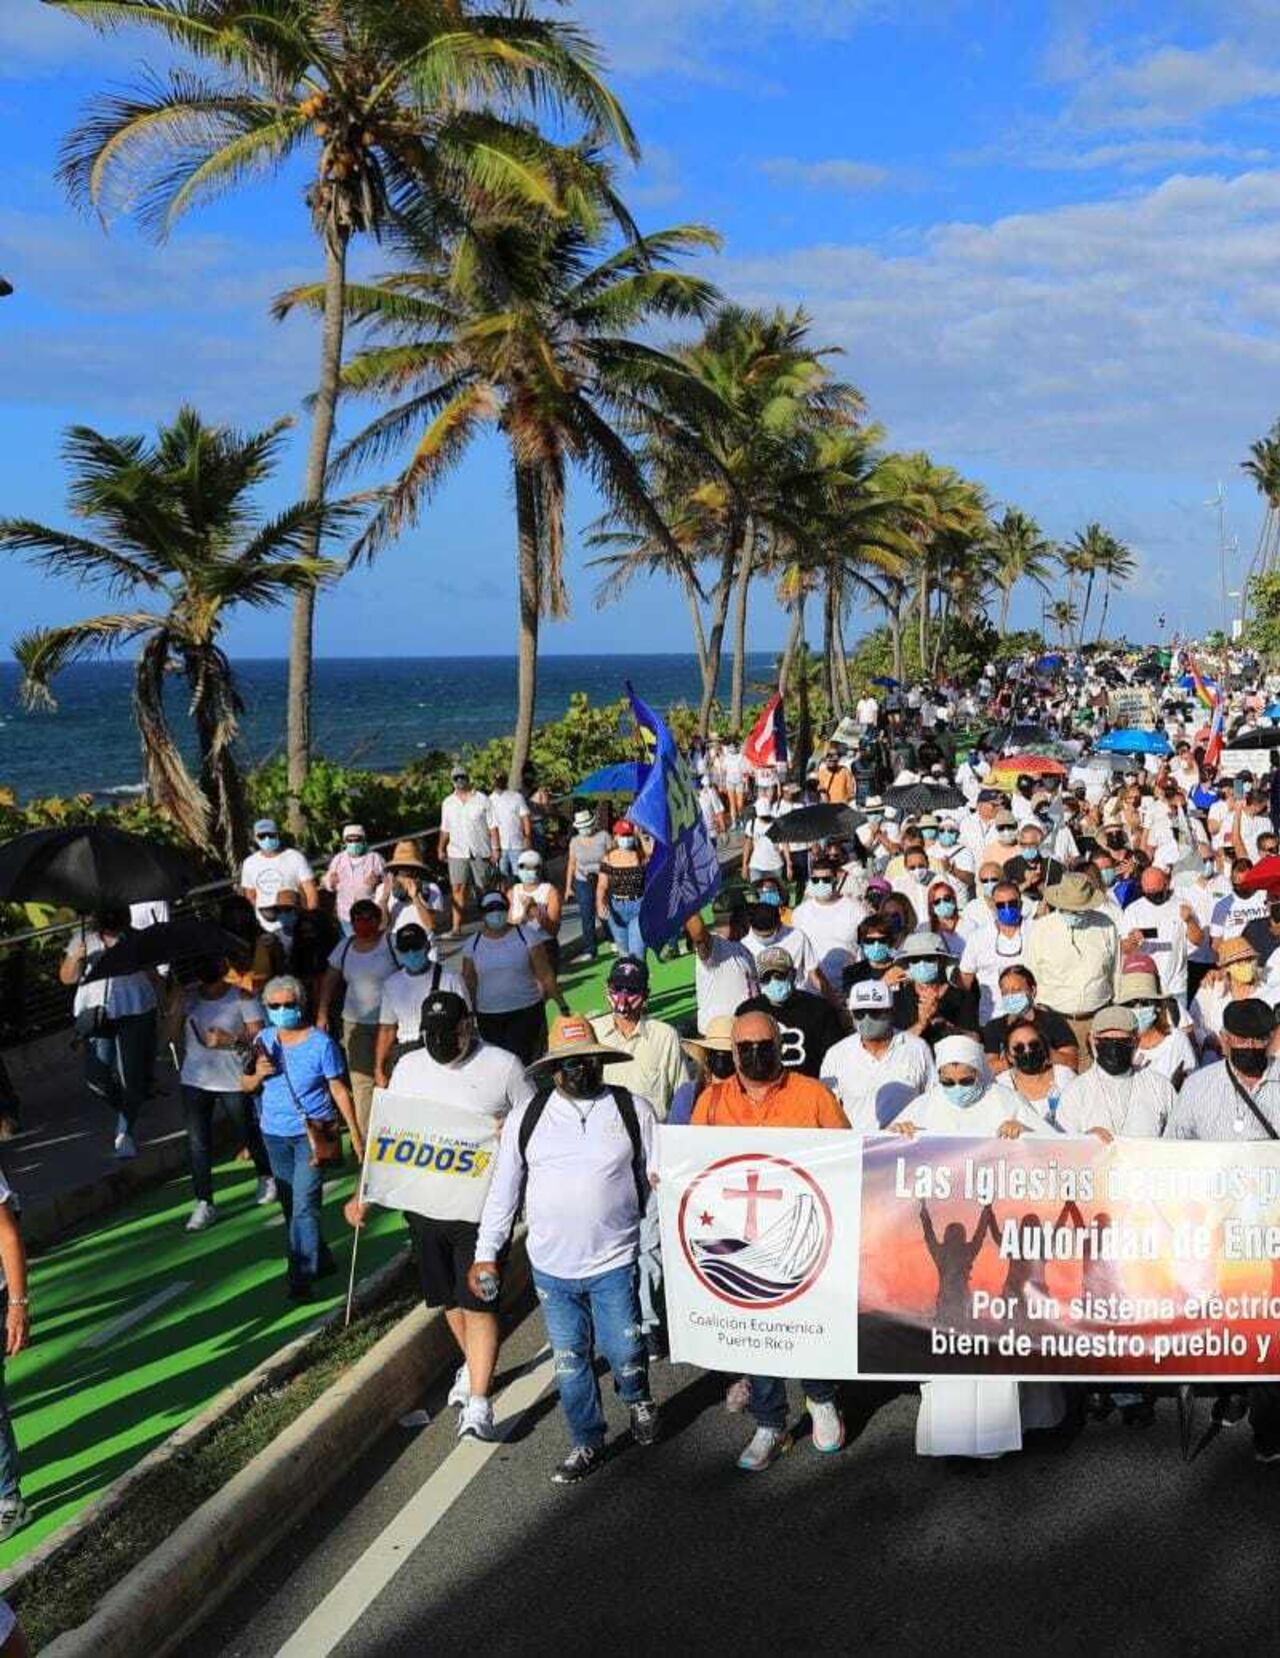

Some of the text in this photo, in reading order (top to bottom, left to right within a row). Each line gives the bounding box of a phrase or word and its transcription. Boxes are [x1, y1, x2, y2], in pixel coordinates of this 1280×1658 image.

[376, 1137, 476, 1173] TODOS
[895, 1159, 952, 1199] Las
[964, 1160, 1094, 1205] Iglesias
[999, 1219, 1157, 1260] Autoridad
[1171, 1220, 1210, 1258] de
[972, 1292, 1018, 1319] Por
[1028, 1299, 1060, 1320] un
[1070, 1293, 1175, 1321] sistema
[717, 1332, 794, 1350] Puerto Rico
[931, 1328, 988, 1356] bien
[998, 1331, 1032, 1356] de
[1041, 1330, 1145, 1357] nuestro
[1153, 1329, 1248, 1362] pueblo
[1256, 1335, 1271, 1363] y
